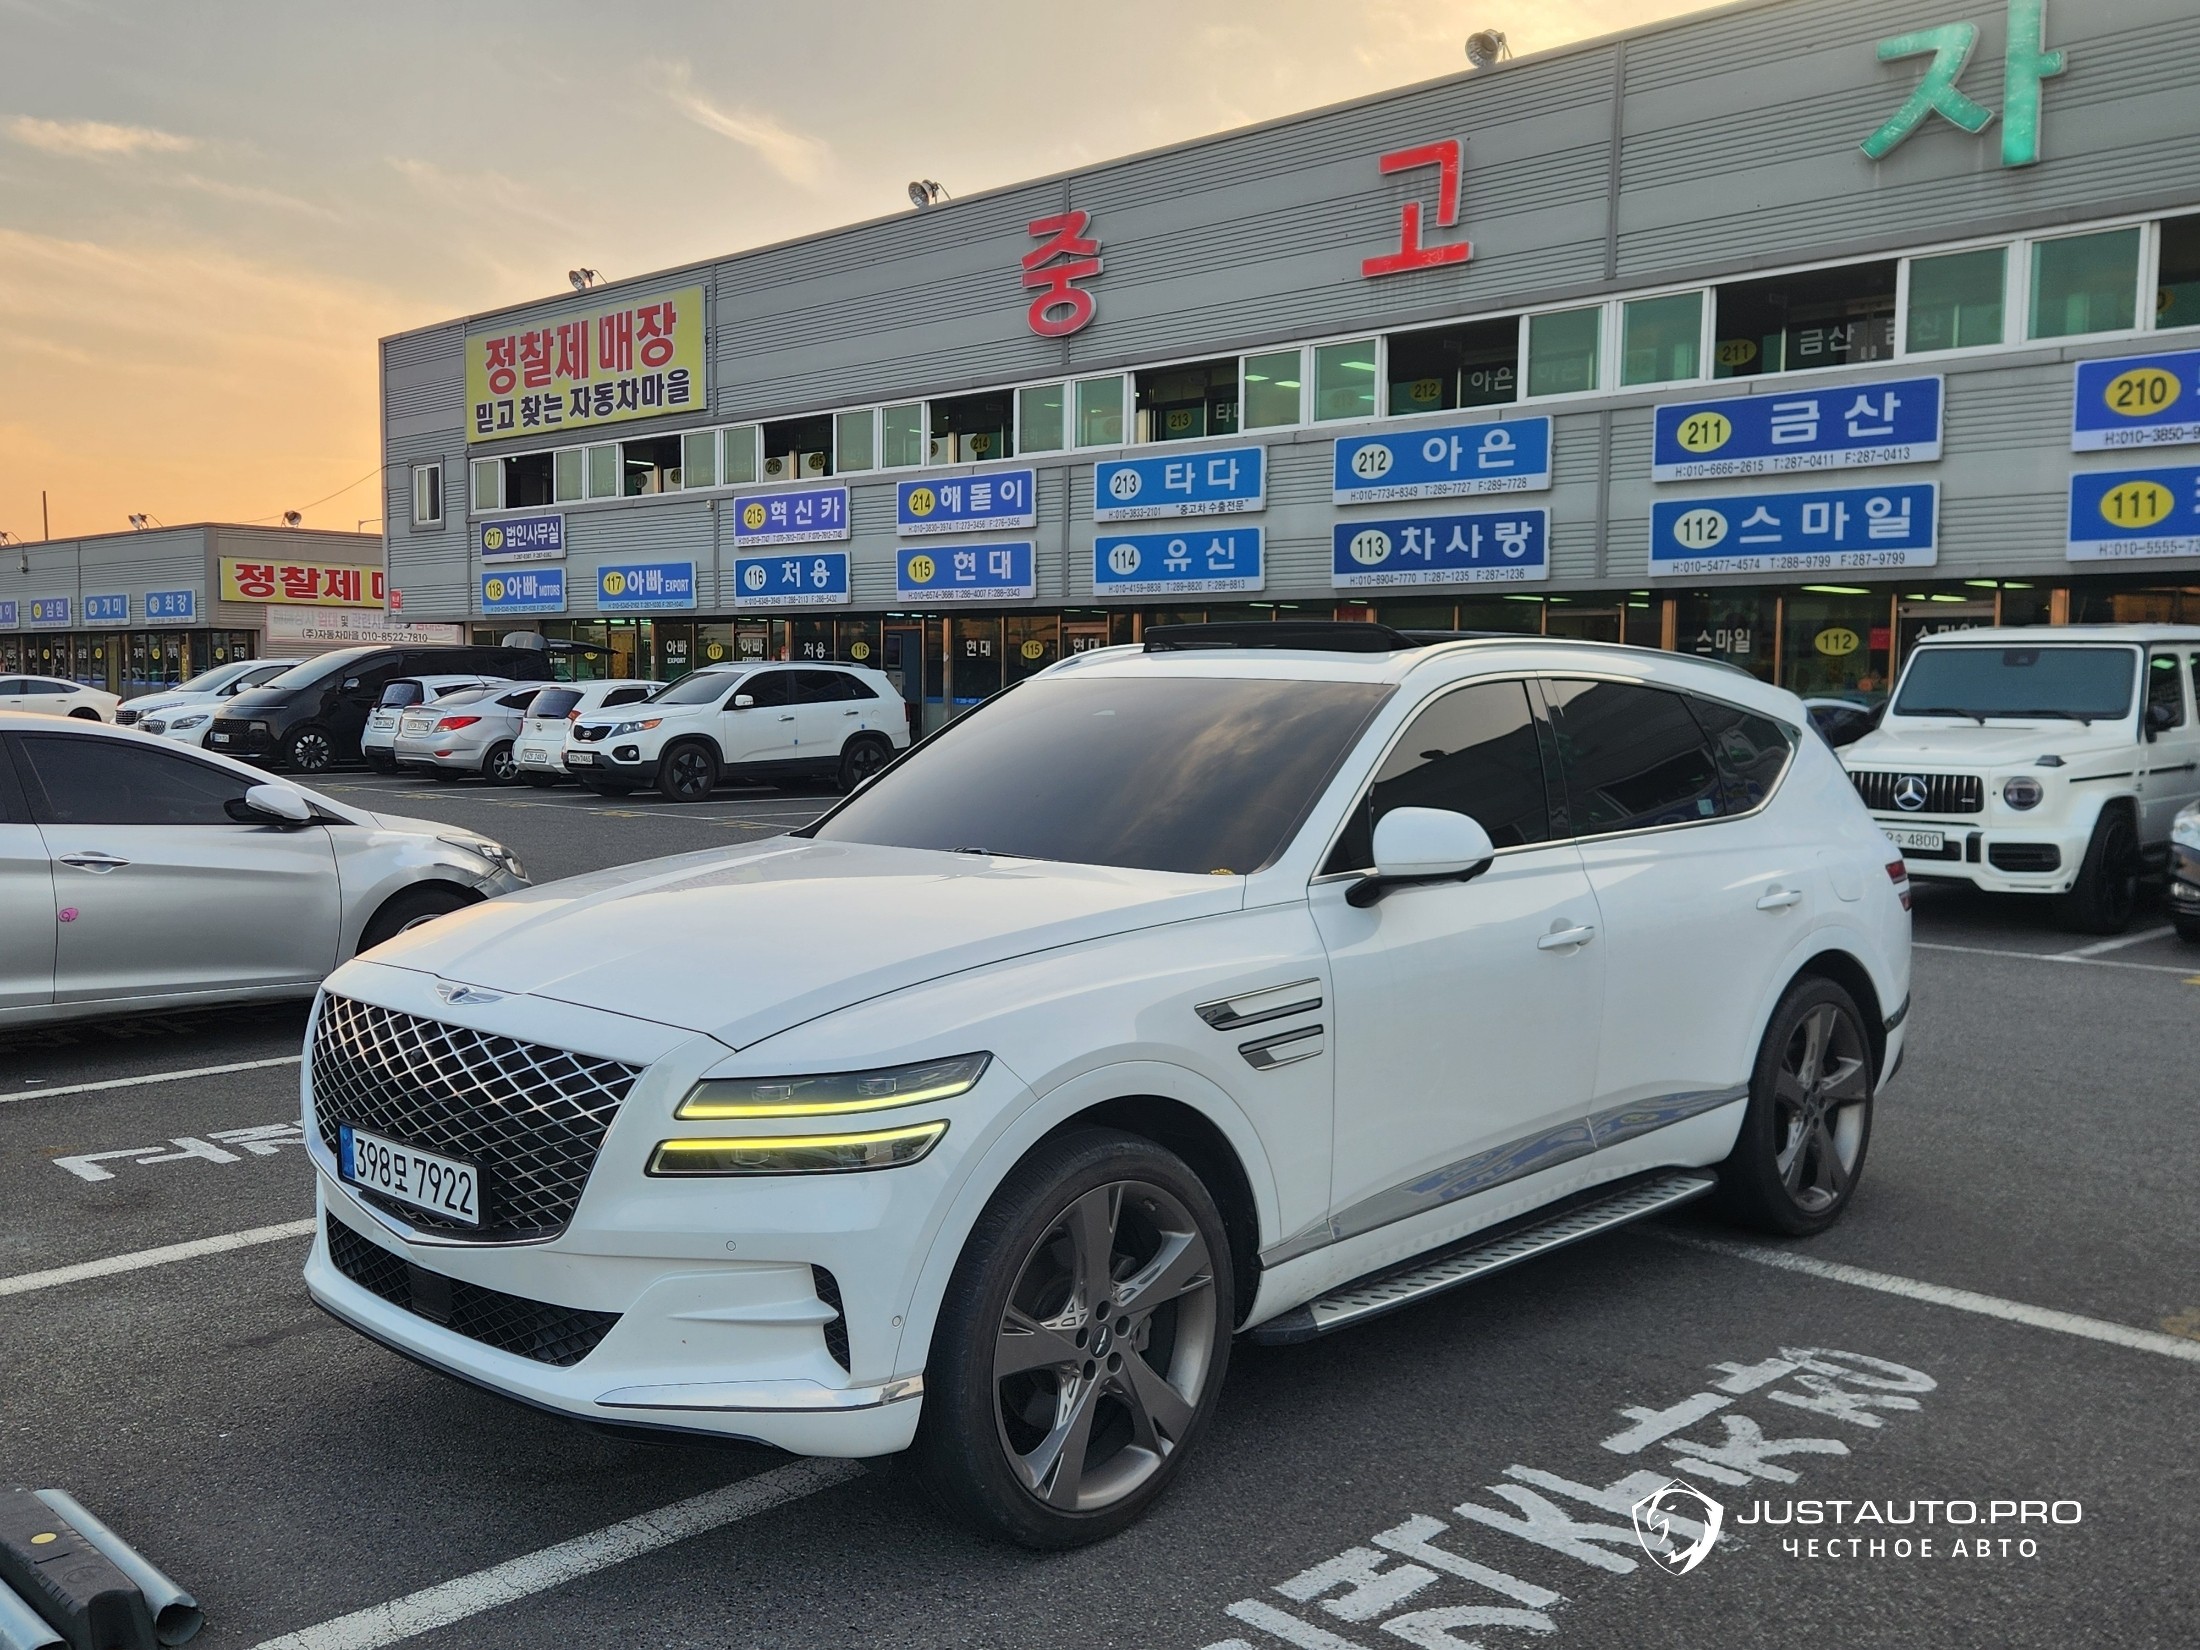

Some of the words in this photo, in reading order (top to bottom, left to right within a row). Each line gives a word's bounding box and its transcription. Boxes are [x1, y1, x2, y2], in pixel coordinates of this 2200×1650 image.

[1021, 209, 1103, 338] 중
[1360, 138, 1474, 278] 고
[485, 319, 589, 394] 정찰제
[599, 300, 676, 372] 매장
[1800, 324, 1854, 355] 금산
[1471, 366, 1513, 392] 아은
[476, 399, 515, 433] 믿고
[520, 393, 563, 427] 찾는
[569, 368, 690, 417] 자동차마을
[1414, 382, 1436, 399] 212
[2117, 376, 2168, 407] 210
[1171, 413, 1189, 427] 213
[1771, 391, 1901, 445] 금산
[973, 437, 988, 449] 214
[1688, 420, 1721, 445] 211
[810, 455, 824, 467] 215
[1422, 428, 1516, 472] 아은
[767, 461, 780, 472] 216
[1358, 450, 1386, 473] 212
[1675, 460, 1764, 477] H:010-6666-2615
[1773, 454, 1834, 470] T:287-0411
[1845, 447, 1910, 464] F:287-0413
[1114, 473, 1137, 495] 213
[1164, 457, 1240, 495] 타다
[940, 479, 1023, 513] 해돋이
[1350, 486, 1418, 501] H:010-7734-8349
[1424, 482, 1471, 496] T:289-7727
[1478, 477, 1527, 493] F:289-7728
[770, 496, 840, 527] 혁신카
[912, 491, 931, 512] 214
[2114, 489, 2157, 519] 111
[747, 508, 763, 524] 215
[1739, 496, 1911, 544] 스마일
[487, 531, 501, 546] 217
[506, 522, 559, 548] 법인사무실
[1683, 517, 1718, 541] 112
[1357, 536, 1384, 558] 113
[1400, 520, 1533, 561] 차사랑
[1114, 547, 1135, 568] 114
[1163, 536, 1236, 572] 유신
[1672, 558, 1760, 573] H:010-5477-4574
[1770, 555, 1831, 569] T:288-9799
[1840, 552, 1905, 566] F:287-9799
[781, 558, 831, 589] 처용
[912, 558, 931, 577] 115
[953, 550, 1012, 581] 현대
[1424, 570, 1469, 583] T:287-1235
[1476, 568, 1525, 581] F:287-1236
[235, 563, 361, 601] 정찰제
[506, 575, 538, 600] 아빠
[539, 584, 560, 597] MOTORS
[607, 576, 621, 591] 117
[627, 569, 663, 595] 아빠
[665, 578, 689, 592] EXPORT
[748, 569, 763, 586] 116
[488, 582, 502, 597] 118
[46, 601, 64, 618] 삼원
[102, 598, 122, 615] 개미
[165, 594, 187, 613] 최강
[341, 615, 349, 628] 및
[302, 628, 360, 642] (주)자동차마을
[361, 631, 428, 643] 010-8522-7810
[740, 638, 763, 655] 아빠
[1696, 628, 1750, 653] 스마일
[1823, 633, 1852, 649] 112
[666, 639, 688, 655] 아빠
[708, 647, 722, 657] 117
[803, 641, 826, 659] 처용
[854, 645, 867, 656] 116
[966, 639, 991, 657] 현대
[1025, 643, 1040, 656] 115
[1907, 833, 1940, 848] 4800
[413, 1157, 473, 1216] 7922
